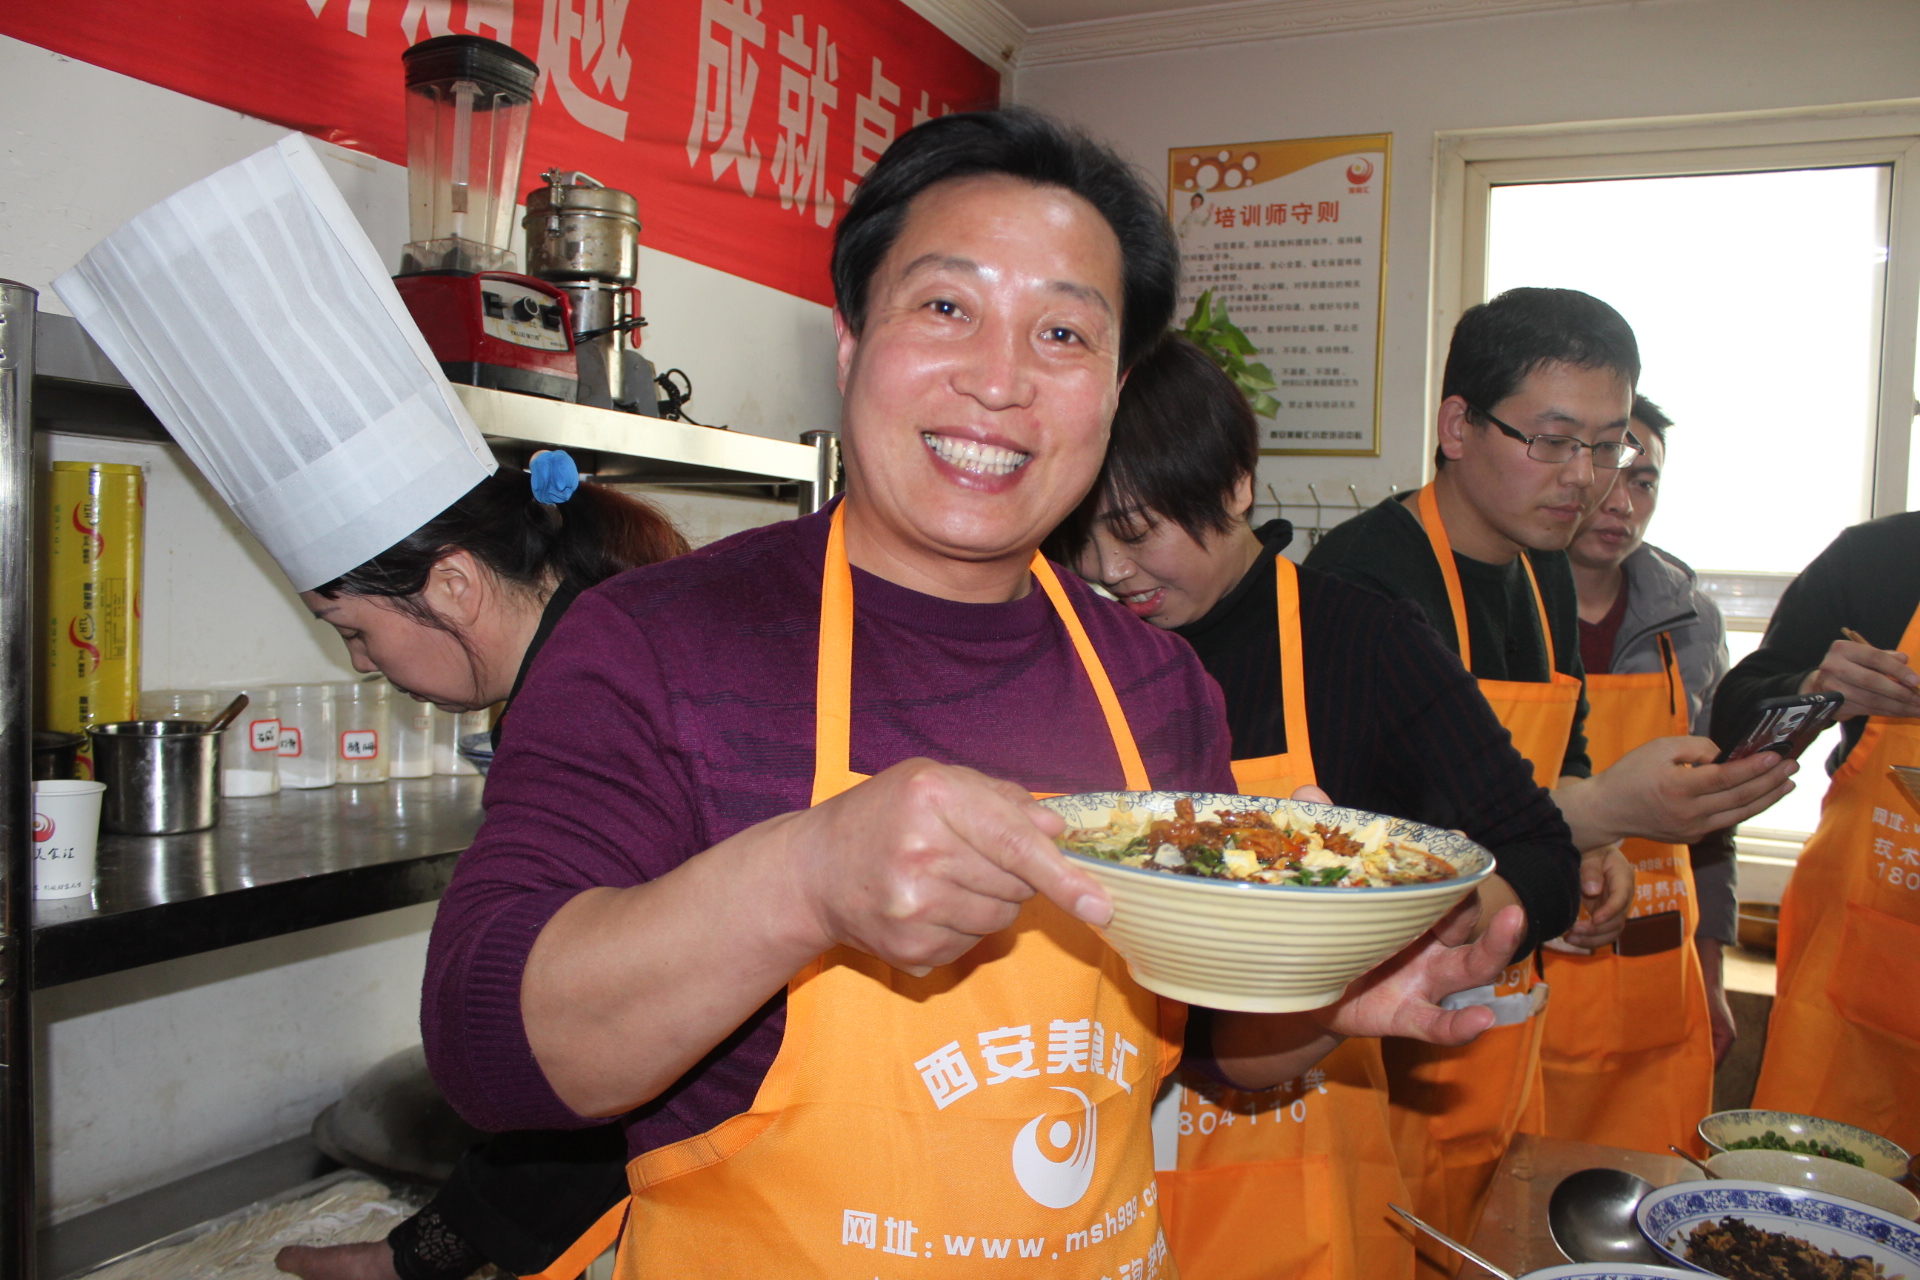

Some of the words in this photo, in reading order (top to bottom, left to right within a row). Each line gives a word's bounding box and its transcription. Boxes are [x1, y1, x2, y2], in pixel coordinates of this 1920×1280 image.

[1214, 201, 1340, 228] 培训师守则
[1873, 837, 1920, 866] 技术
[1876, 862, 1920, 890] 180
[914, 1018, 1139, 1111] 西安美食汇
